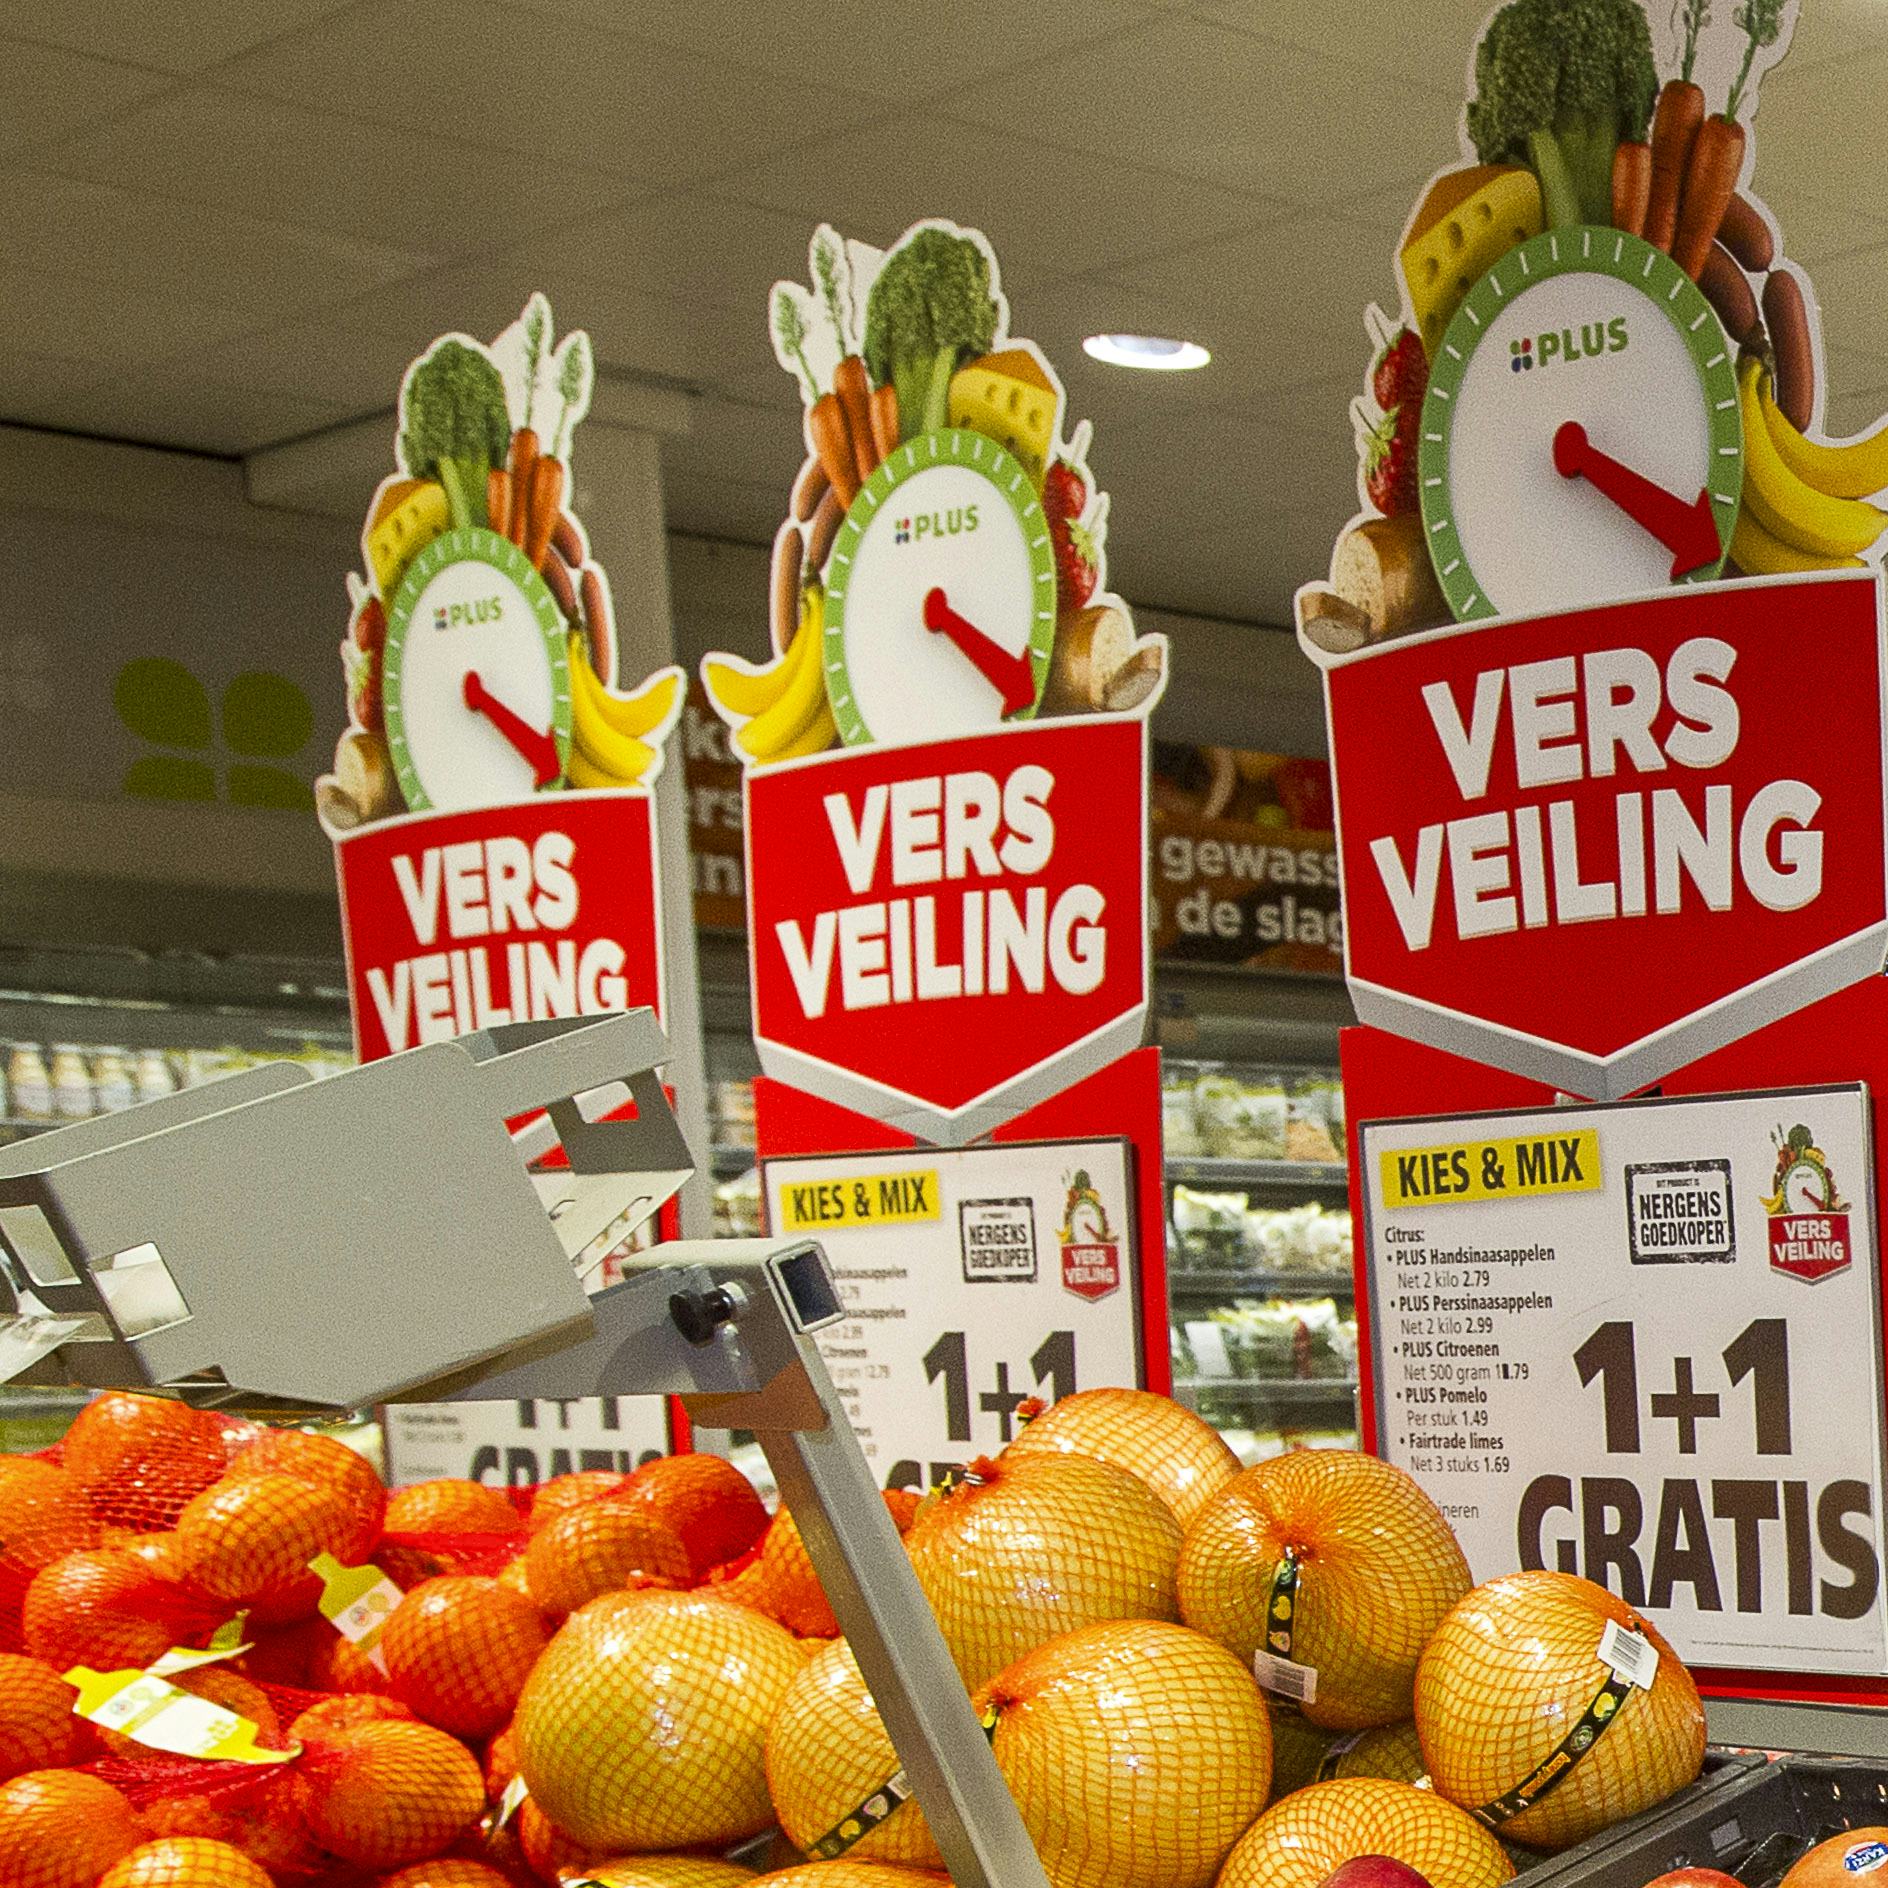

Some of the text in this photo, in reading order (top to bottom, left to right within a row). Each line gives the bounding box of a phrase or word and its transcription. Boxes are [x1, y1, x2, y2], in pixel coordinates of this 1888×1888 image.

[1538, 318, 1630, 368] PLUS
[915, 505, 979, 541] PLUS
[450, 595, 503, 628] PLUS
[1421, 636, 1740, 802] VERS
[823, 765, 1056, 895] VERS
[1368, 779, 1825, 953] VEILING
[392, 831, 580, 945] VERS
[1175, 886, 1242, 939] de
[775, 883, 1106, 1020] VEILING
[366, 938, 628, 1048] VEILING
[1398, 1138, 1583, 1199] KIES & MIX
[793, 1177, 928, 1222] KIES & MIX
[1640, 1191, 1721, 1220] NERGENS
[969, 1224, 1027, 1246] NERGENS
[1384, 1226, 1424, 1243] Citrus:
[1641, 1220, 1726, 1247] GOEDKOPER
[1784, 1220, 1831, 1240] VERS
[1396, 1244, 1555, 1266] PLUS Handsinaasappelen
[1773, 1240, 1844, 1262] VEILING
[1398, 1270, 1490, 1289] Net 2 kilo 2.79
[1399, 1291, 1553, 1314] PLUS Perssinaasappelen
[1401, 1317, 1493, 1335] Net 2 kilo 2.99
[1402, 1340, 1499, 1357] PLUS Citroenen
[1404, 1364, 1490, 1385] Net 500 gram
[1573, 1318, 1792, 1456] 1+1
[1405, 1386, 1487, 1403] PLUS Pomelo
[1407, 1408, 1488, 1427] Per stuk 1.49
[1409, 1433, 1503, 1450] Fairtrade limes
[1411, 1455, 1510, 1473] Net 3 stuks 1.69
[1517, 1474, 1879, 1620] GRATIS
